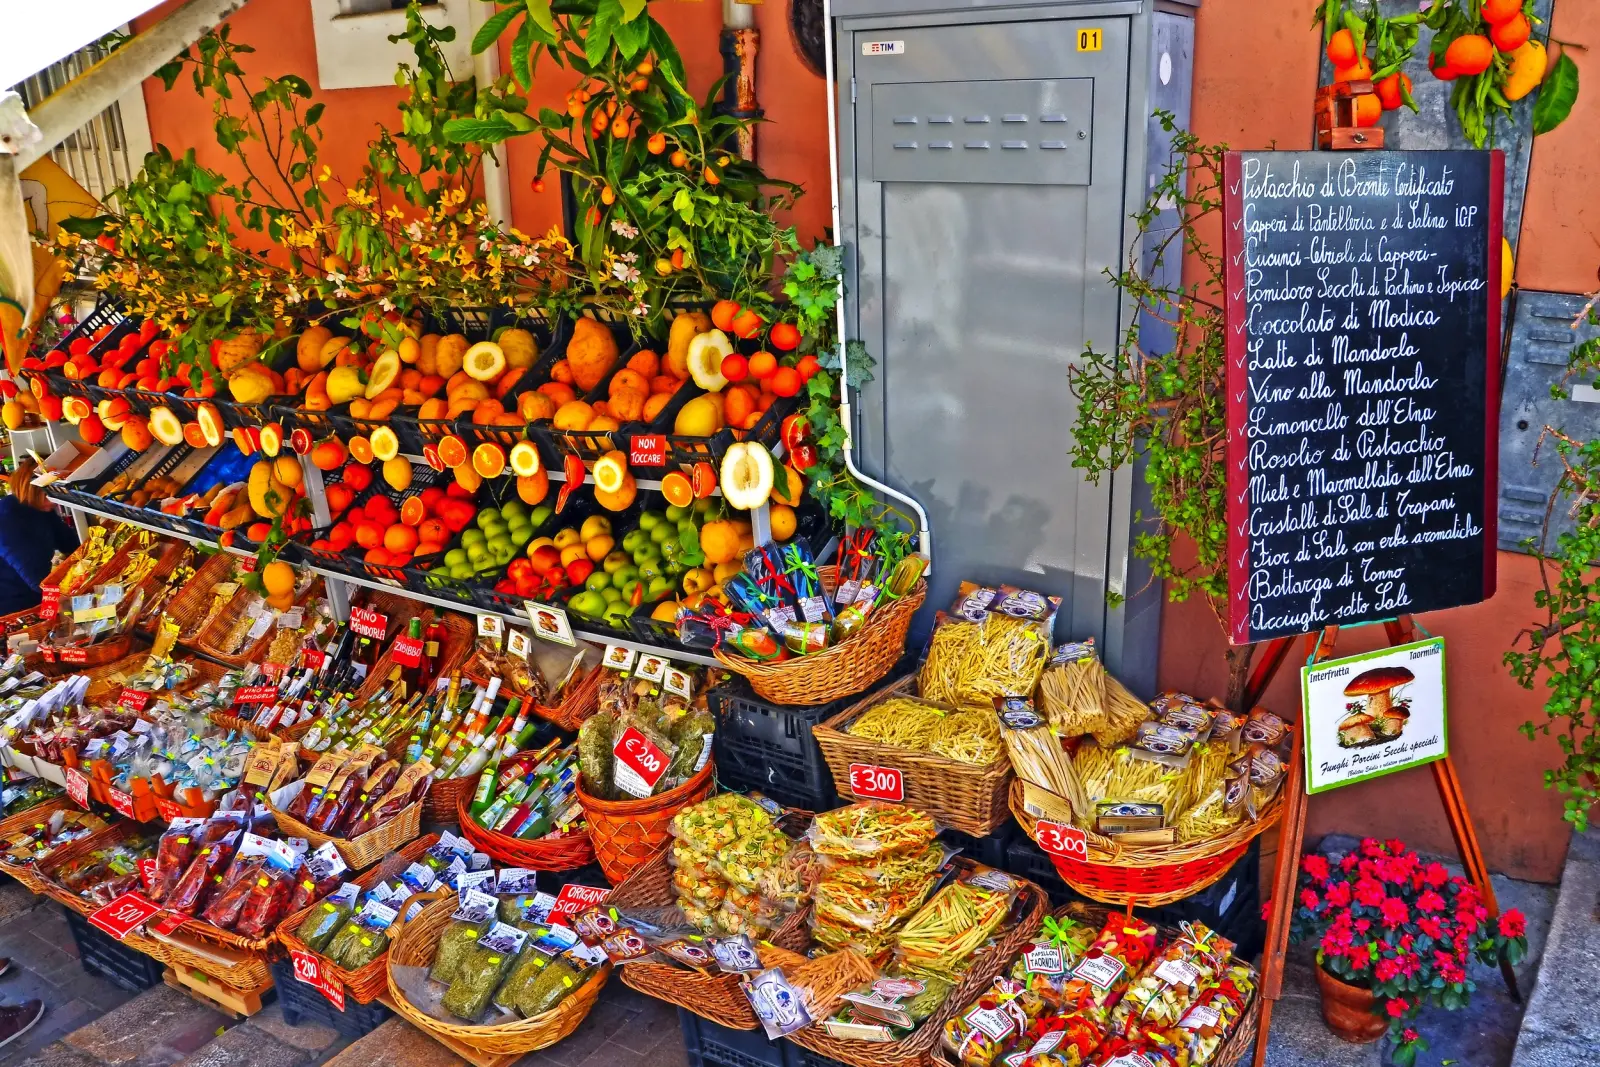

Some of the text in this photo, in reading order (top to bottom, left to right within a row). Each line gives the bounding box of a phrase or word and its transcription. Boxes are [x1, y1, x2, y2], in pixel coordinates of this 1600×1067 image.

[880, 43, 894, 51] TIM
[1242, 158, 1453, 200] Pistacchio di Bronte Certificato
[1244, 203, 1287, 241] Capperi
[1291, 205, 1303, 231] di
[1308, 203, 1375, 233] Pantelleria
[1381, 217, 1388, 230] e
[1392, 203, 1404, 228] di
[1408, 202, 1447, 228] Salina
[1245, 236, 1302, 267] Cucunci
[1358, 238, 1372, 262] di
[1246, 265, 1486, 302] Pomidoro Secchi di Pachino e Ispica
[1249, 300, 1440, 336] Cioccolato di Modica
[1248, 333, 1419, 370] Latte di Mandorla
[1248, 362, 1438, 402] Vino alla Mandorla
[1248, 398, 1436, 437] Limoncello dell'Etna
[630, 452, 661, 464] TOCCARE
[638, 438, 656, 449] NON
[1249, 424, 1445, 472] Rosolio di Pistacchio
[1249, 452, 1474, 504] Miele e Marmellata dell'Etna
[1249, 490, 1455, 536] Cristalli di Sale di Trapani
[1252, 513, 1482, 568] Fior di Sale con erbe aromatiche
[1248, 557, 1405, 602] Bottarga di Tonno
[356, 609, 377, 622] VINO
[1249, 582, 1412, 632] Acciughe sotto Sale
[350, 622, 386, 640] MANDORLA
[1410, 643, 1440, 660] Taormina
[1310, 666, 1350, 683] Interfrutta
[1320, 735, 1439, 775] Funghi Porcini Secchi speciali
